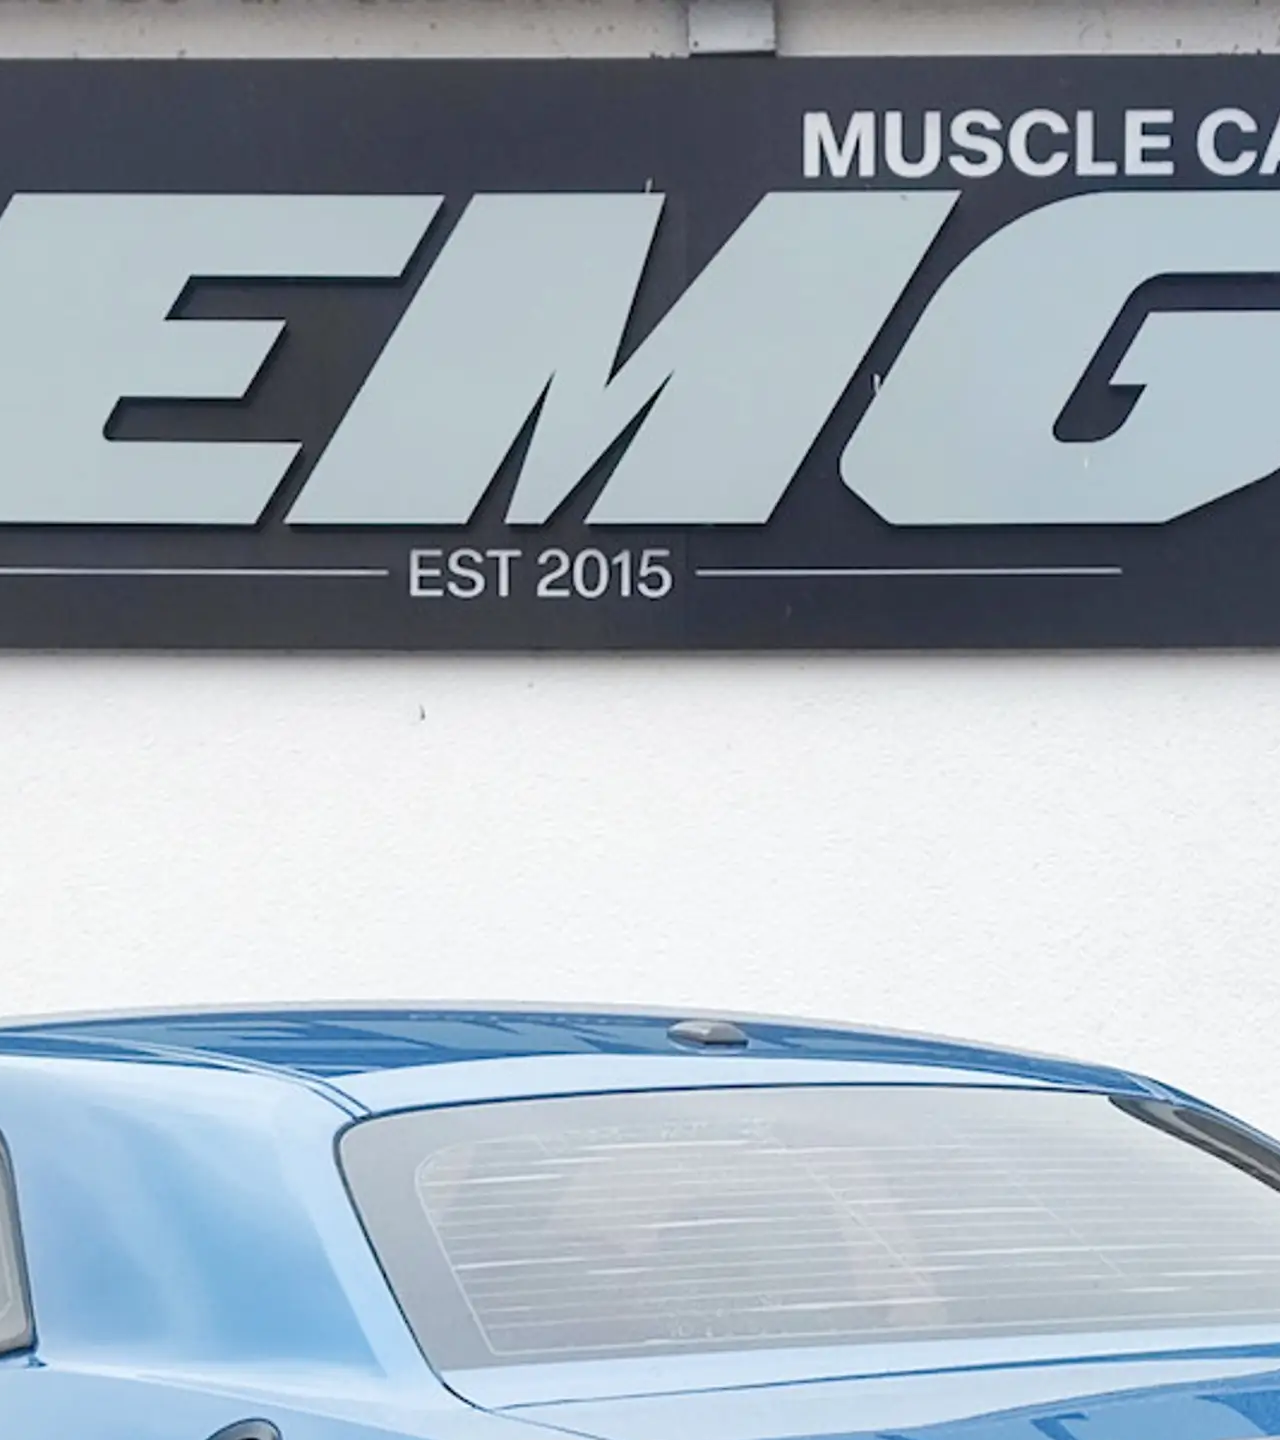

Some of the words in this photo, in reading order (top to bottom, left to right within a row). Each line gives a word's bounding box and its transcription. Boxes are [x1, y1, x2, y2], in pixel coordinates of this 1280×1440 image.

[803, 108, 1175, 179] MUSCLE
[409, 548, 522, 598] EST
[536, 548, 673, 598] 2015
